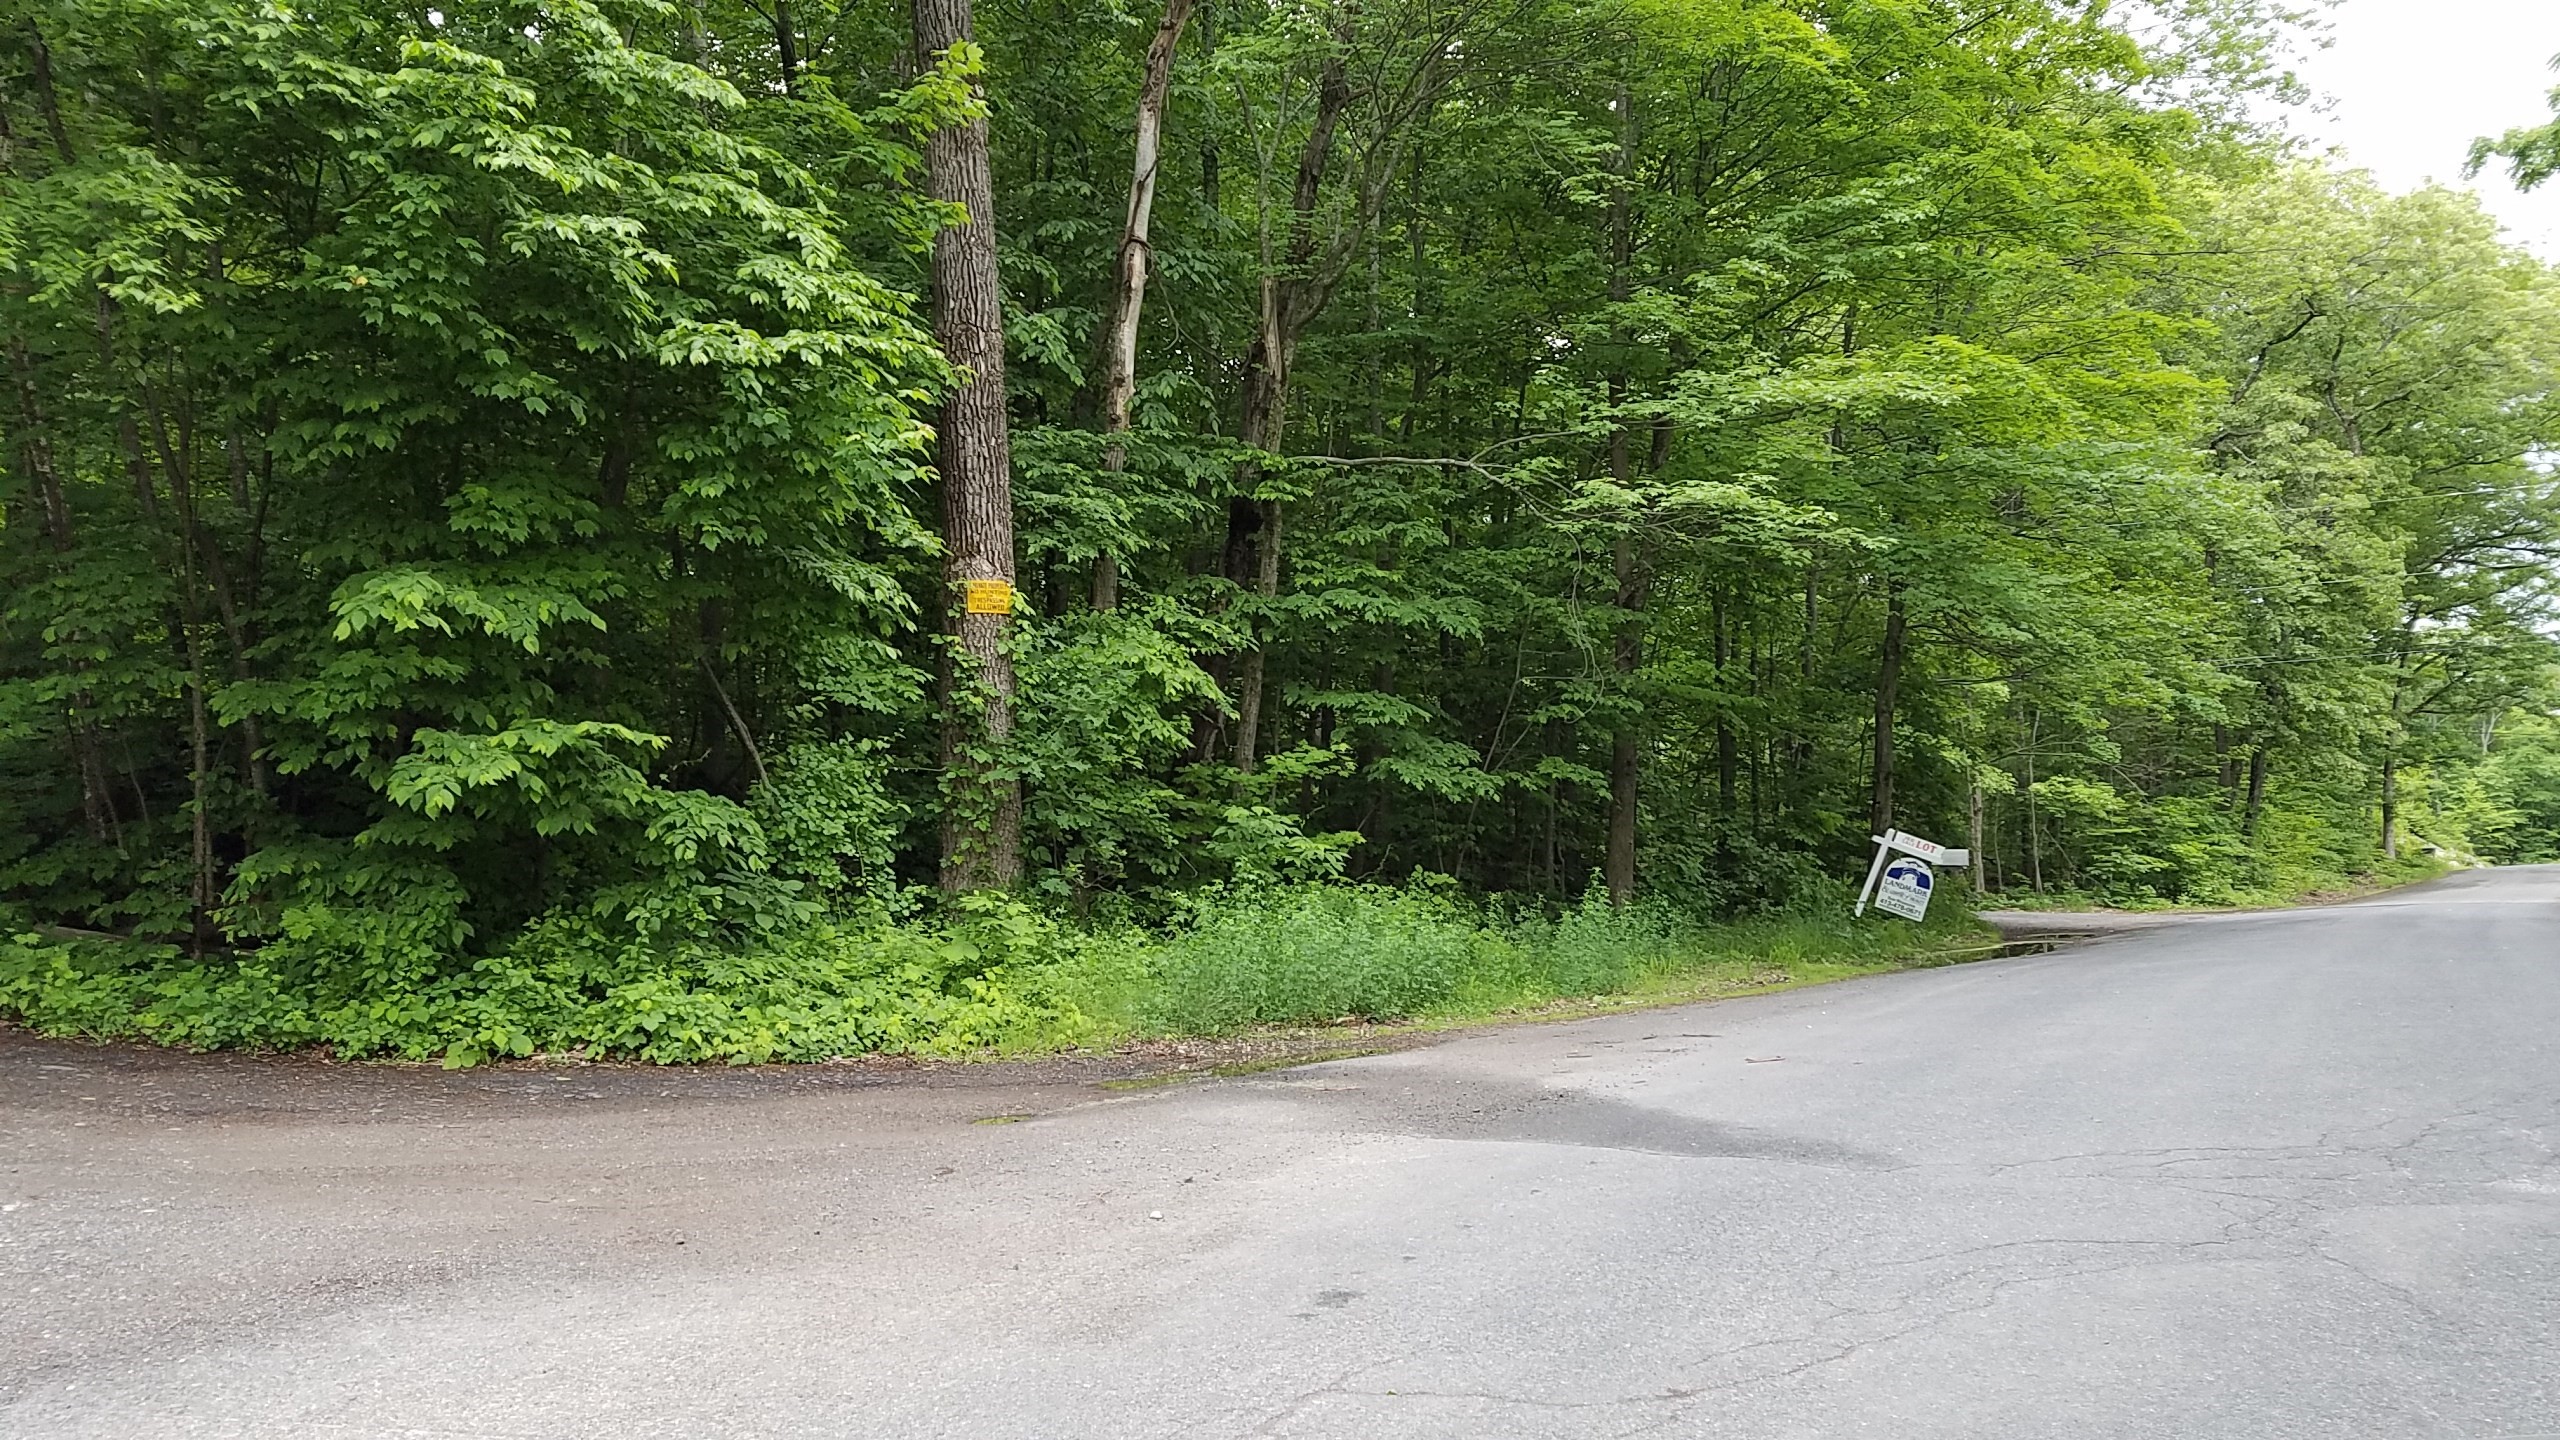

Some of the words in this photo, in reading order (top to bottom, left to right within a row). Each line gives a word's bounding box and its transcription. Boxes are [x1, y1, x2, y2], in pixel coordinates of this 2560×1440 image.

[976, 603, 1005, 611] ALLOWED
[1915, 840, 1937, 854] LOT
[1884, 878, 1928, 898] LANDMARK
